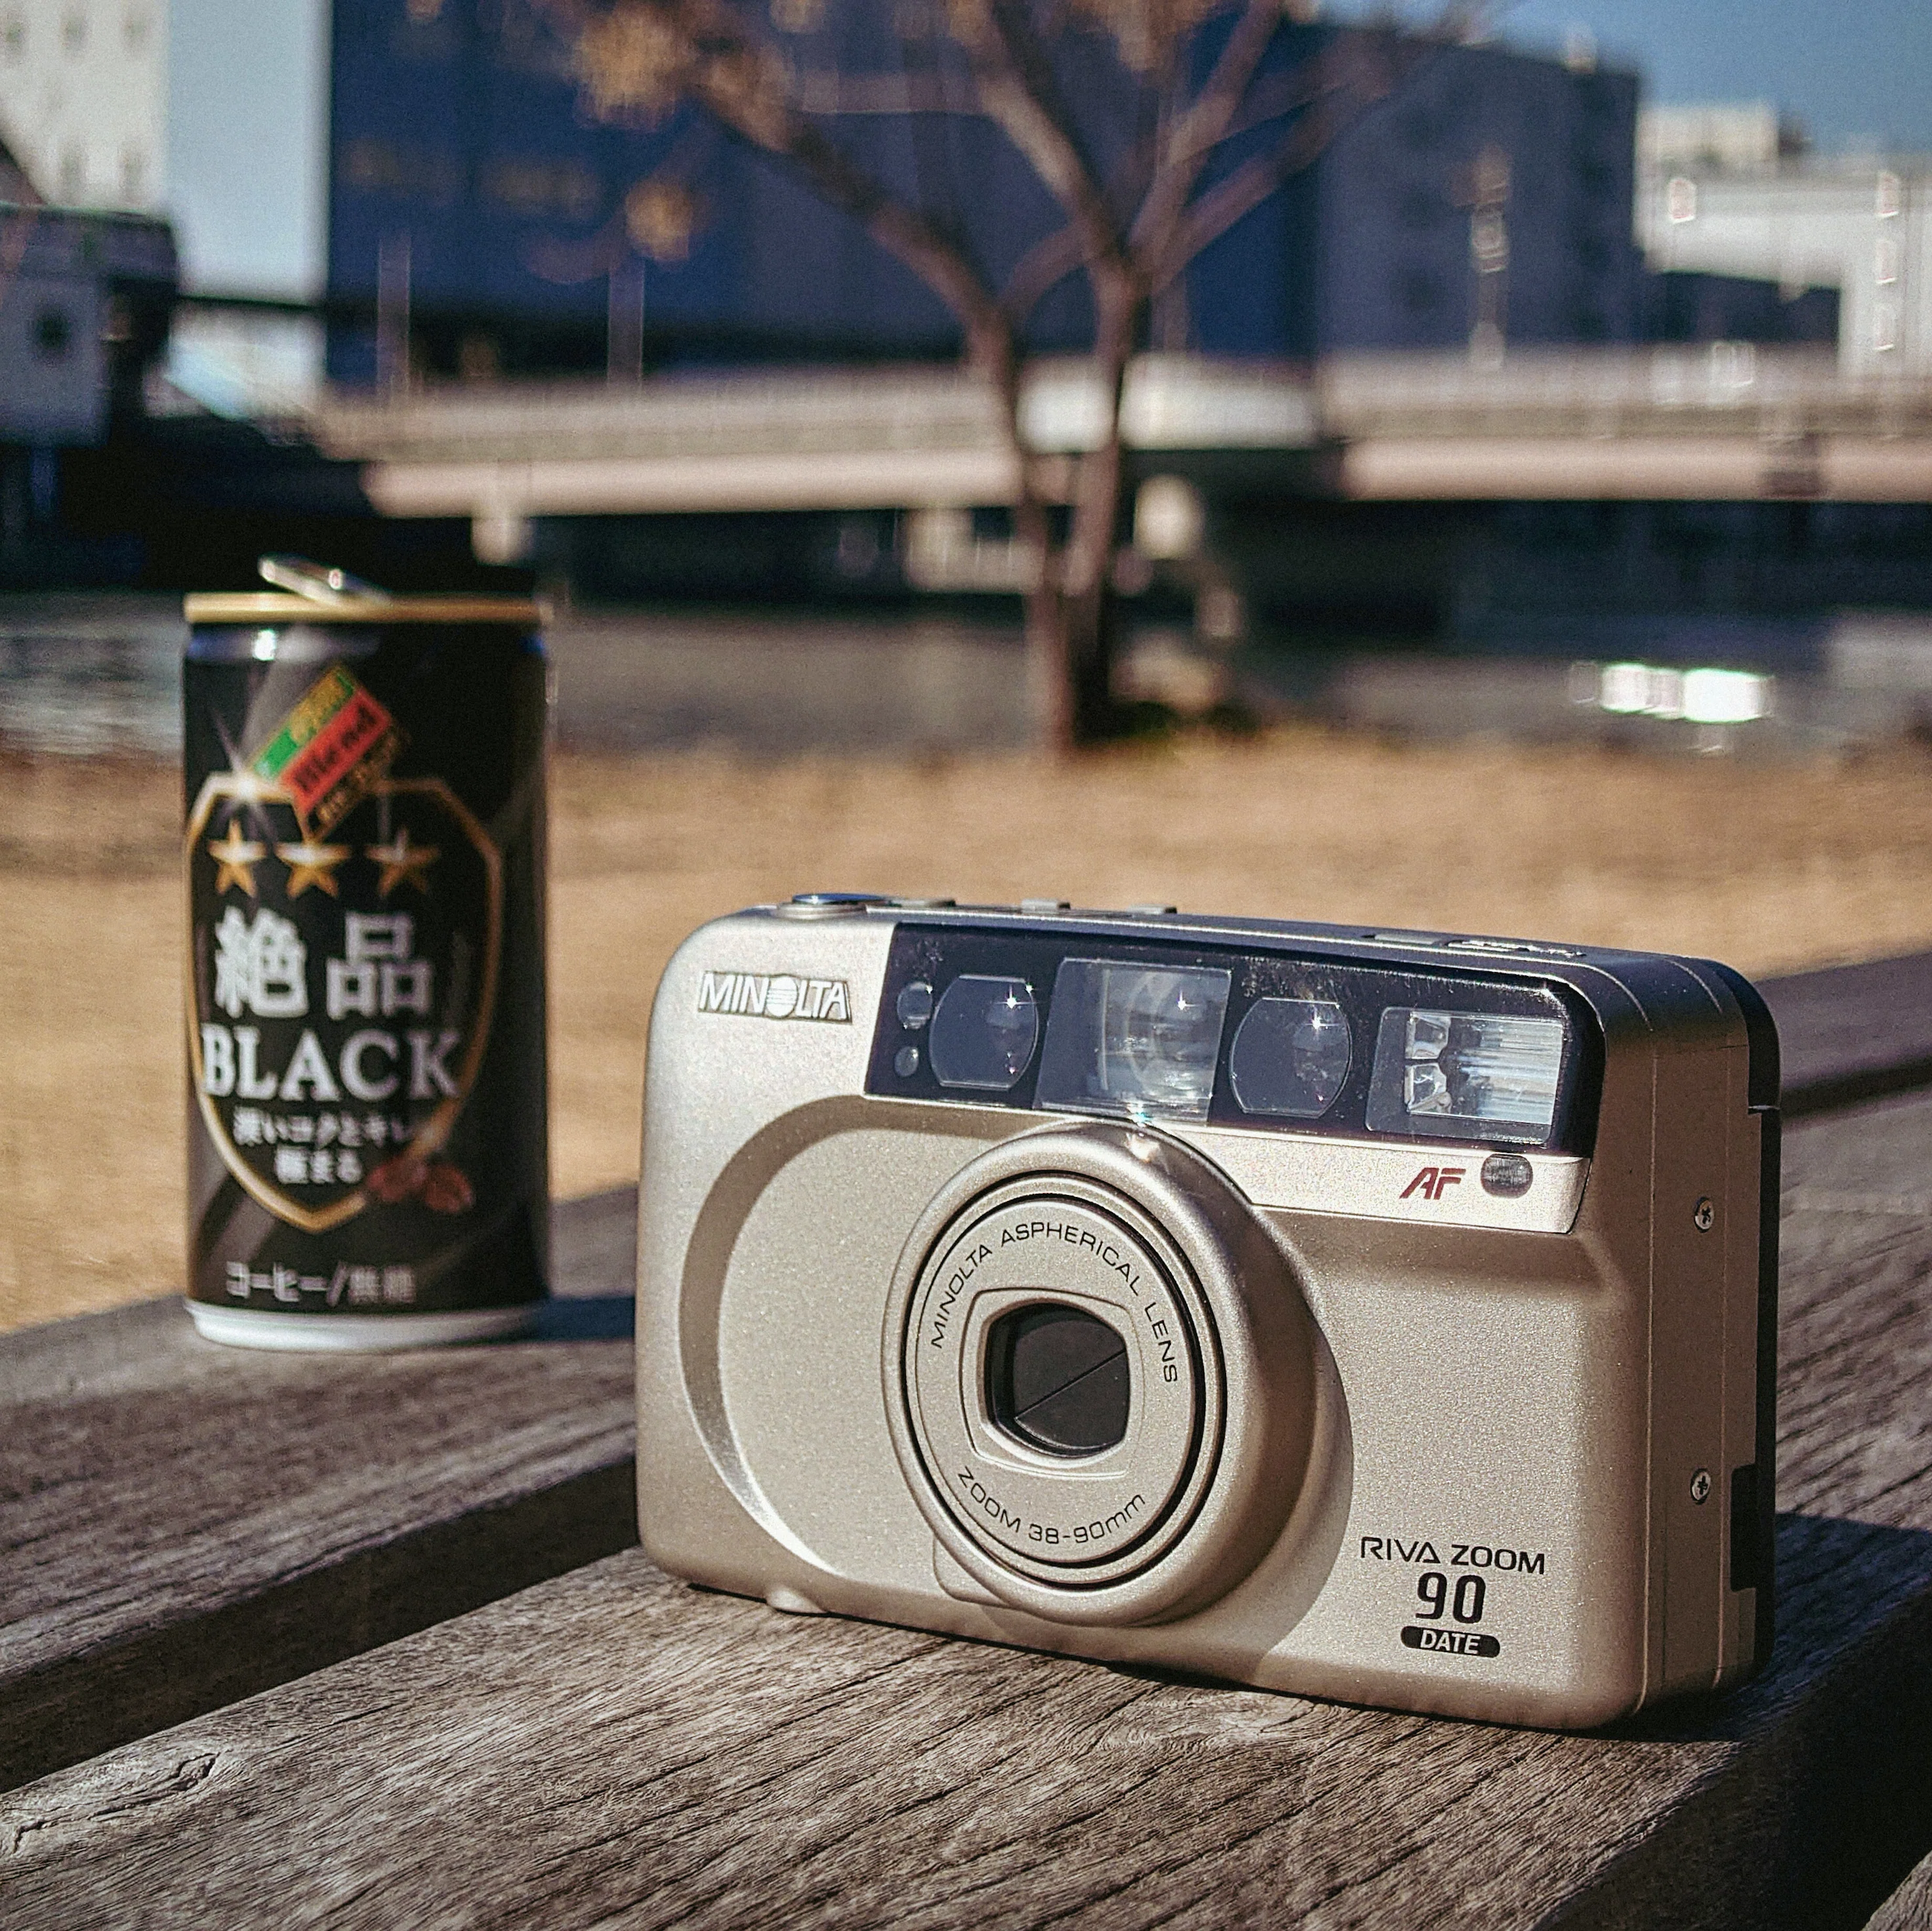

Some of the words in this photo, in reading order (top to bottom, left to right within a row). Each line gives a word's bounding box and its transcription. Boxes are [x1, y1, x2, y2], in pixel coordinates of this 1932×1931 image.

[215, 905, 433, 1021] 絶品
[699, 973, 851, 1023] MINOLTA
[200, 1023, 460, 1103] BLACK
[1399, 1167, 1467, 1200] AF
[930, 1244, 993, 1349] MINOLTA
[1000, 1221, 1143, 1297] ASPHERICAL
[1144, 1301, 1178, 1383] LENS
[957, 1465, 1021, 1534] ZOOM
[1027, 1493, 1145, 1545] 38-90mm
[1360, 1536, 1441, 1564] RIVA
[1450, 1543, 1546, 1575] ZOOM
[1414, 1571, 1487, 1624] 90
[1419, 1629, 1482, 1656] DATE
